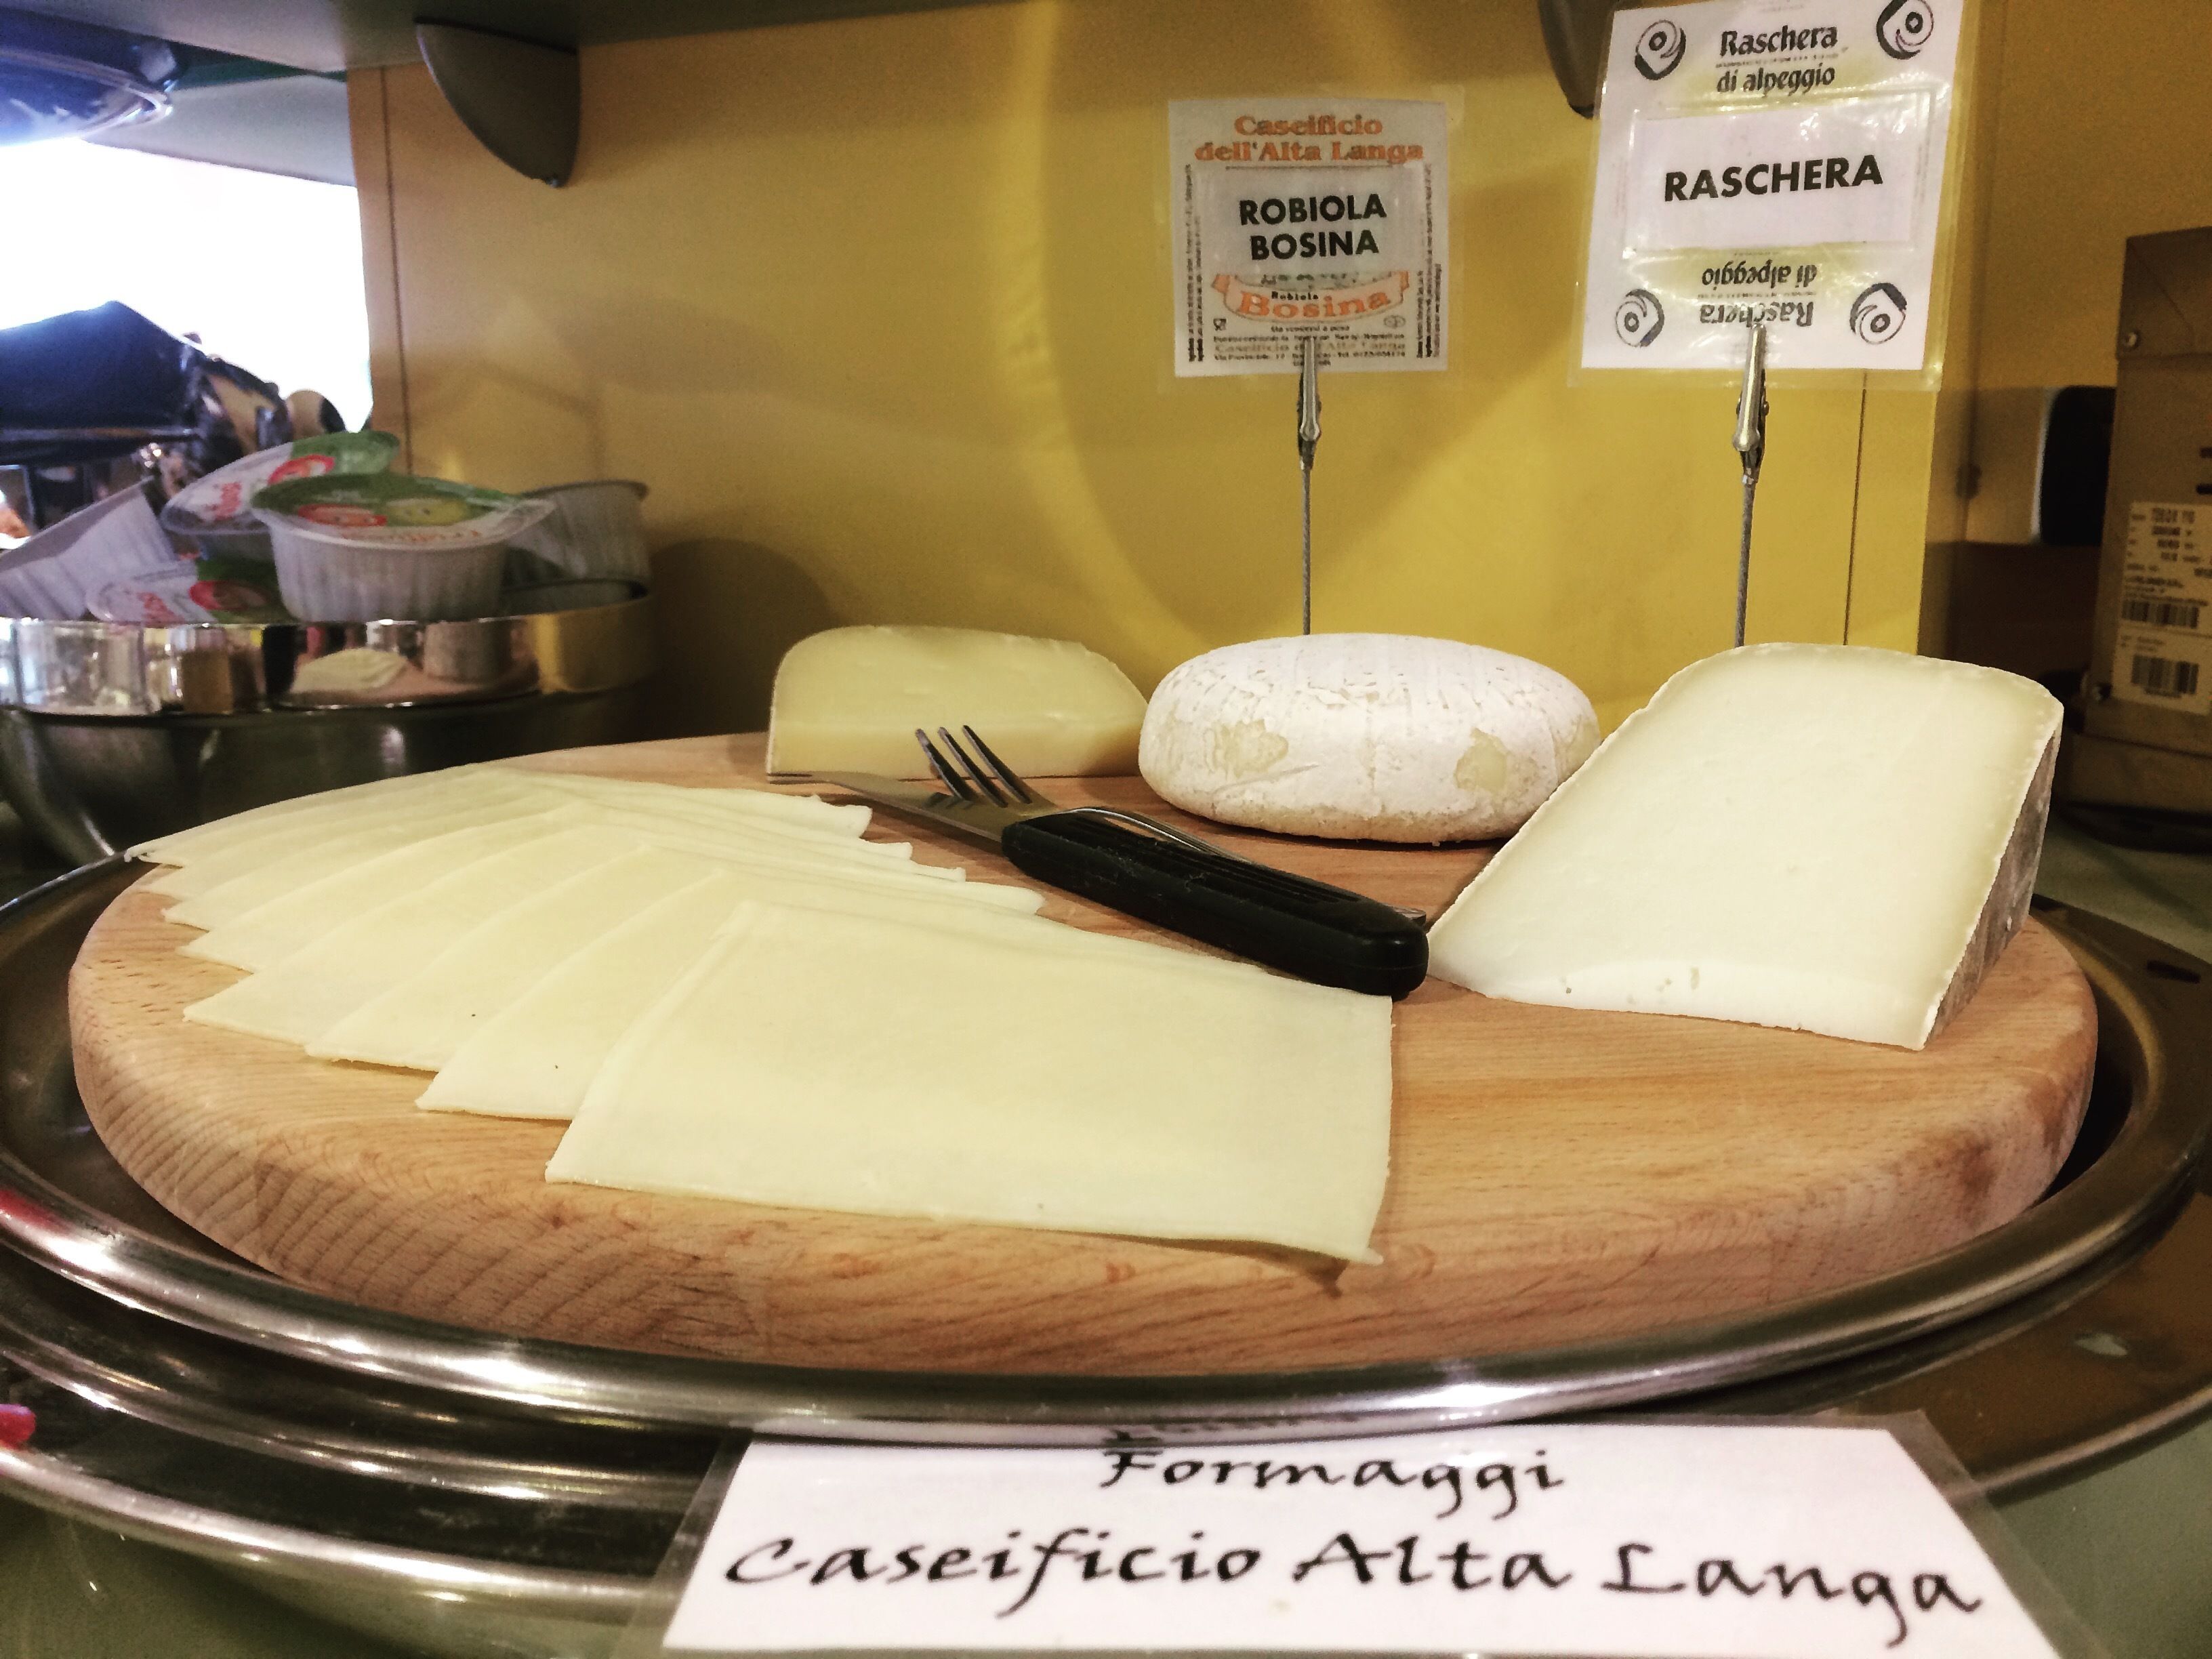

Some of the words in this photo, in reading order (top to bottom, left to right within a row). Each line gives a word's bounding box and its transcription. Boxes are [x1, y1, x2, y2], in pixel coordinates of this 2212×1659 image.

[1719, 24, 1839, 57] Raschera
[1717, 68, 1738, 92] di
[1742, 62, 1836, 95] alpeggio
[1234, 114, 1383, 136] Caseificio
[1194, 141, 1322, 162] dell'Alta
[1331, 141, 1424, 165] Langa
[1664, 155, 1884, 202] RASCHERA
[1239, 192, 1387, 226] ROBIOLA
[1250, 229, 1380, 261] BOSINA
[1702, 259, 1792, 291] alpeggio
[1796, 264, 1818, 287] di
[1237, 289, 1392, 319] Bosina
[1700, 301, 1814, 328] Raschera
[1099, 1449, 1564, 1519] Formaggi
[725, 1527, 1262, 1619] Caseificio
[1293, 1532, 1574, 1591] Alta
[1601, 1542, 1983, 1648] Langa
